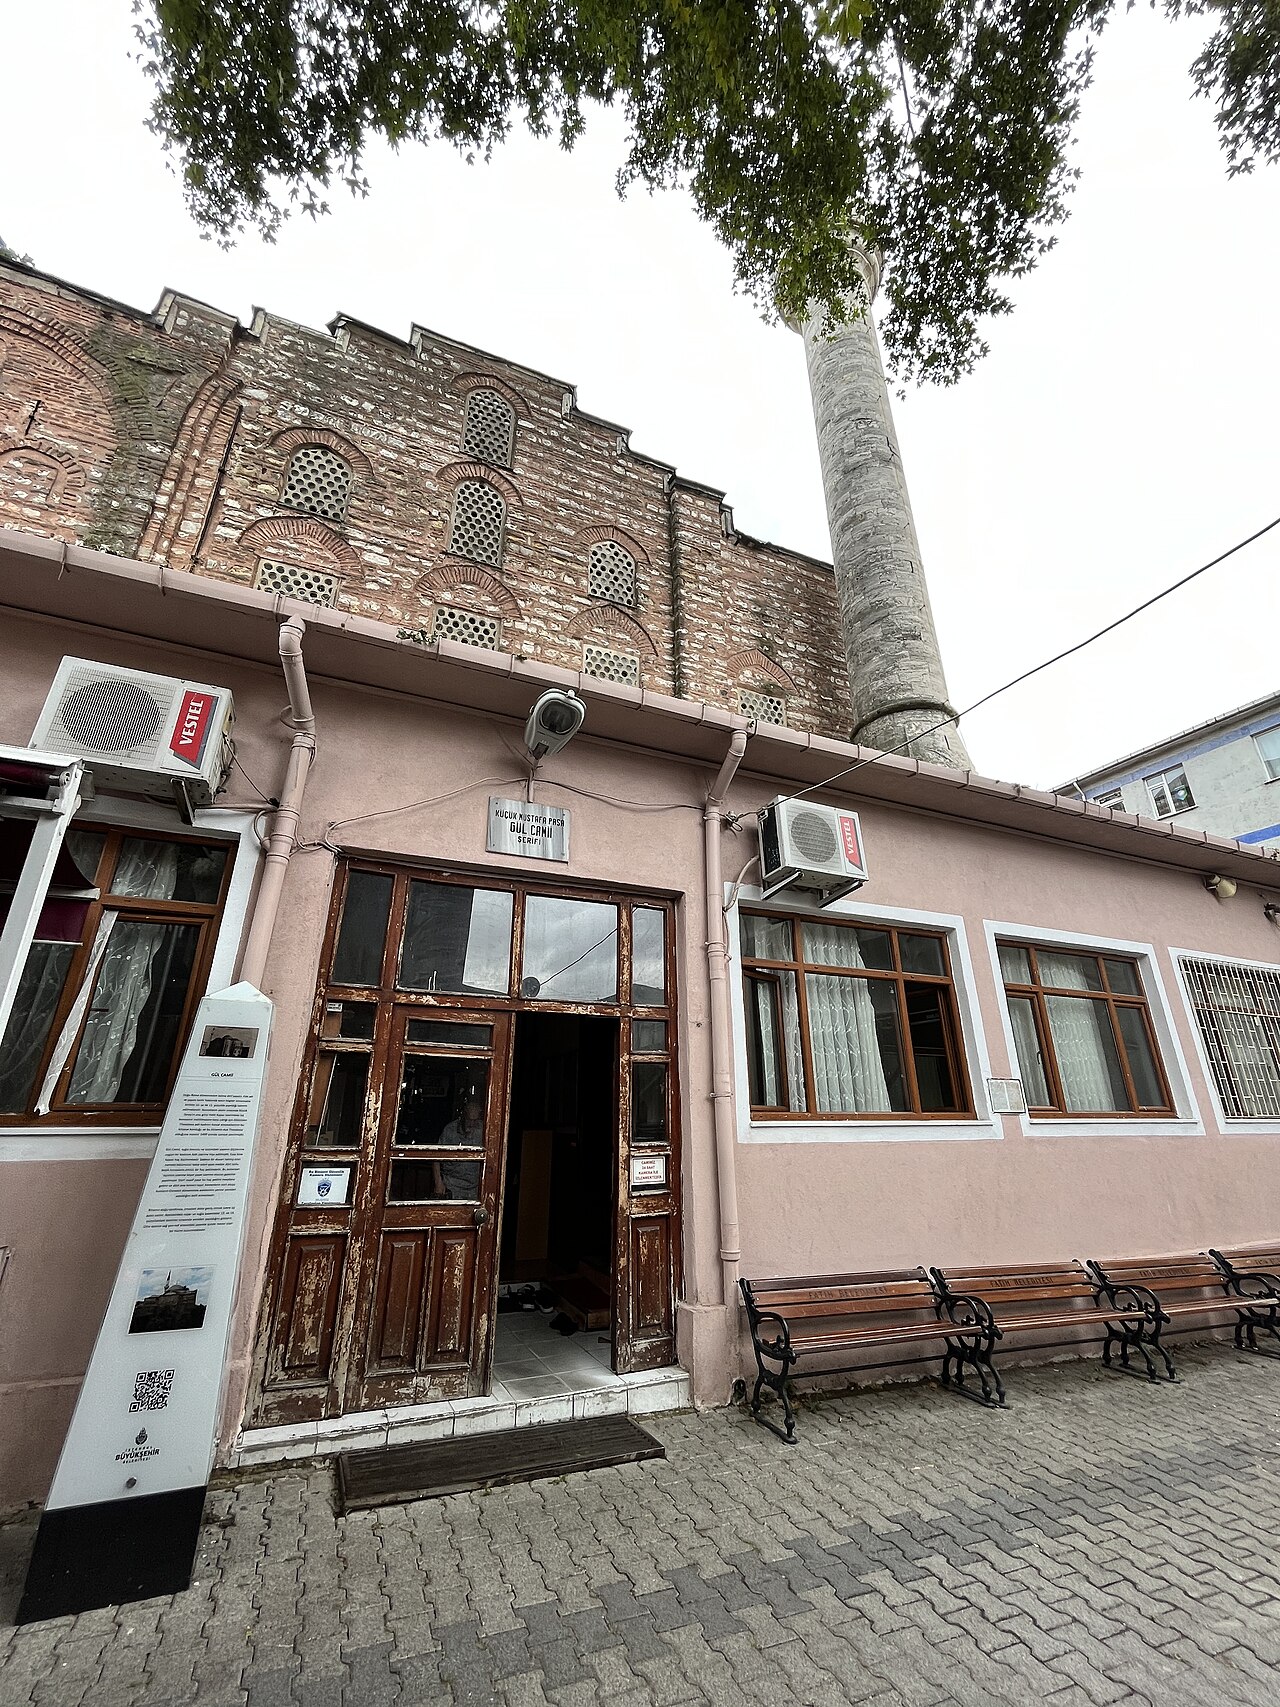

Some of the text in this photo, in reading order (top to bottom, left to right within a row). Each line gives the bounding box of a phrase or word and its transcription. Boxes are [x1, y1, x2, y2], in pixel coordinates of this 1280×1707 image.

[179, 700, 204, 745] VESTEL
[519, 813, 546, 824] MUSTAFA
[843, 820, 855, 855] VESTEL
